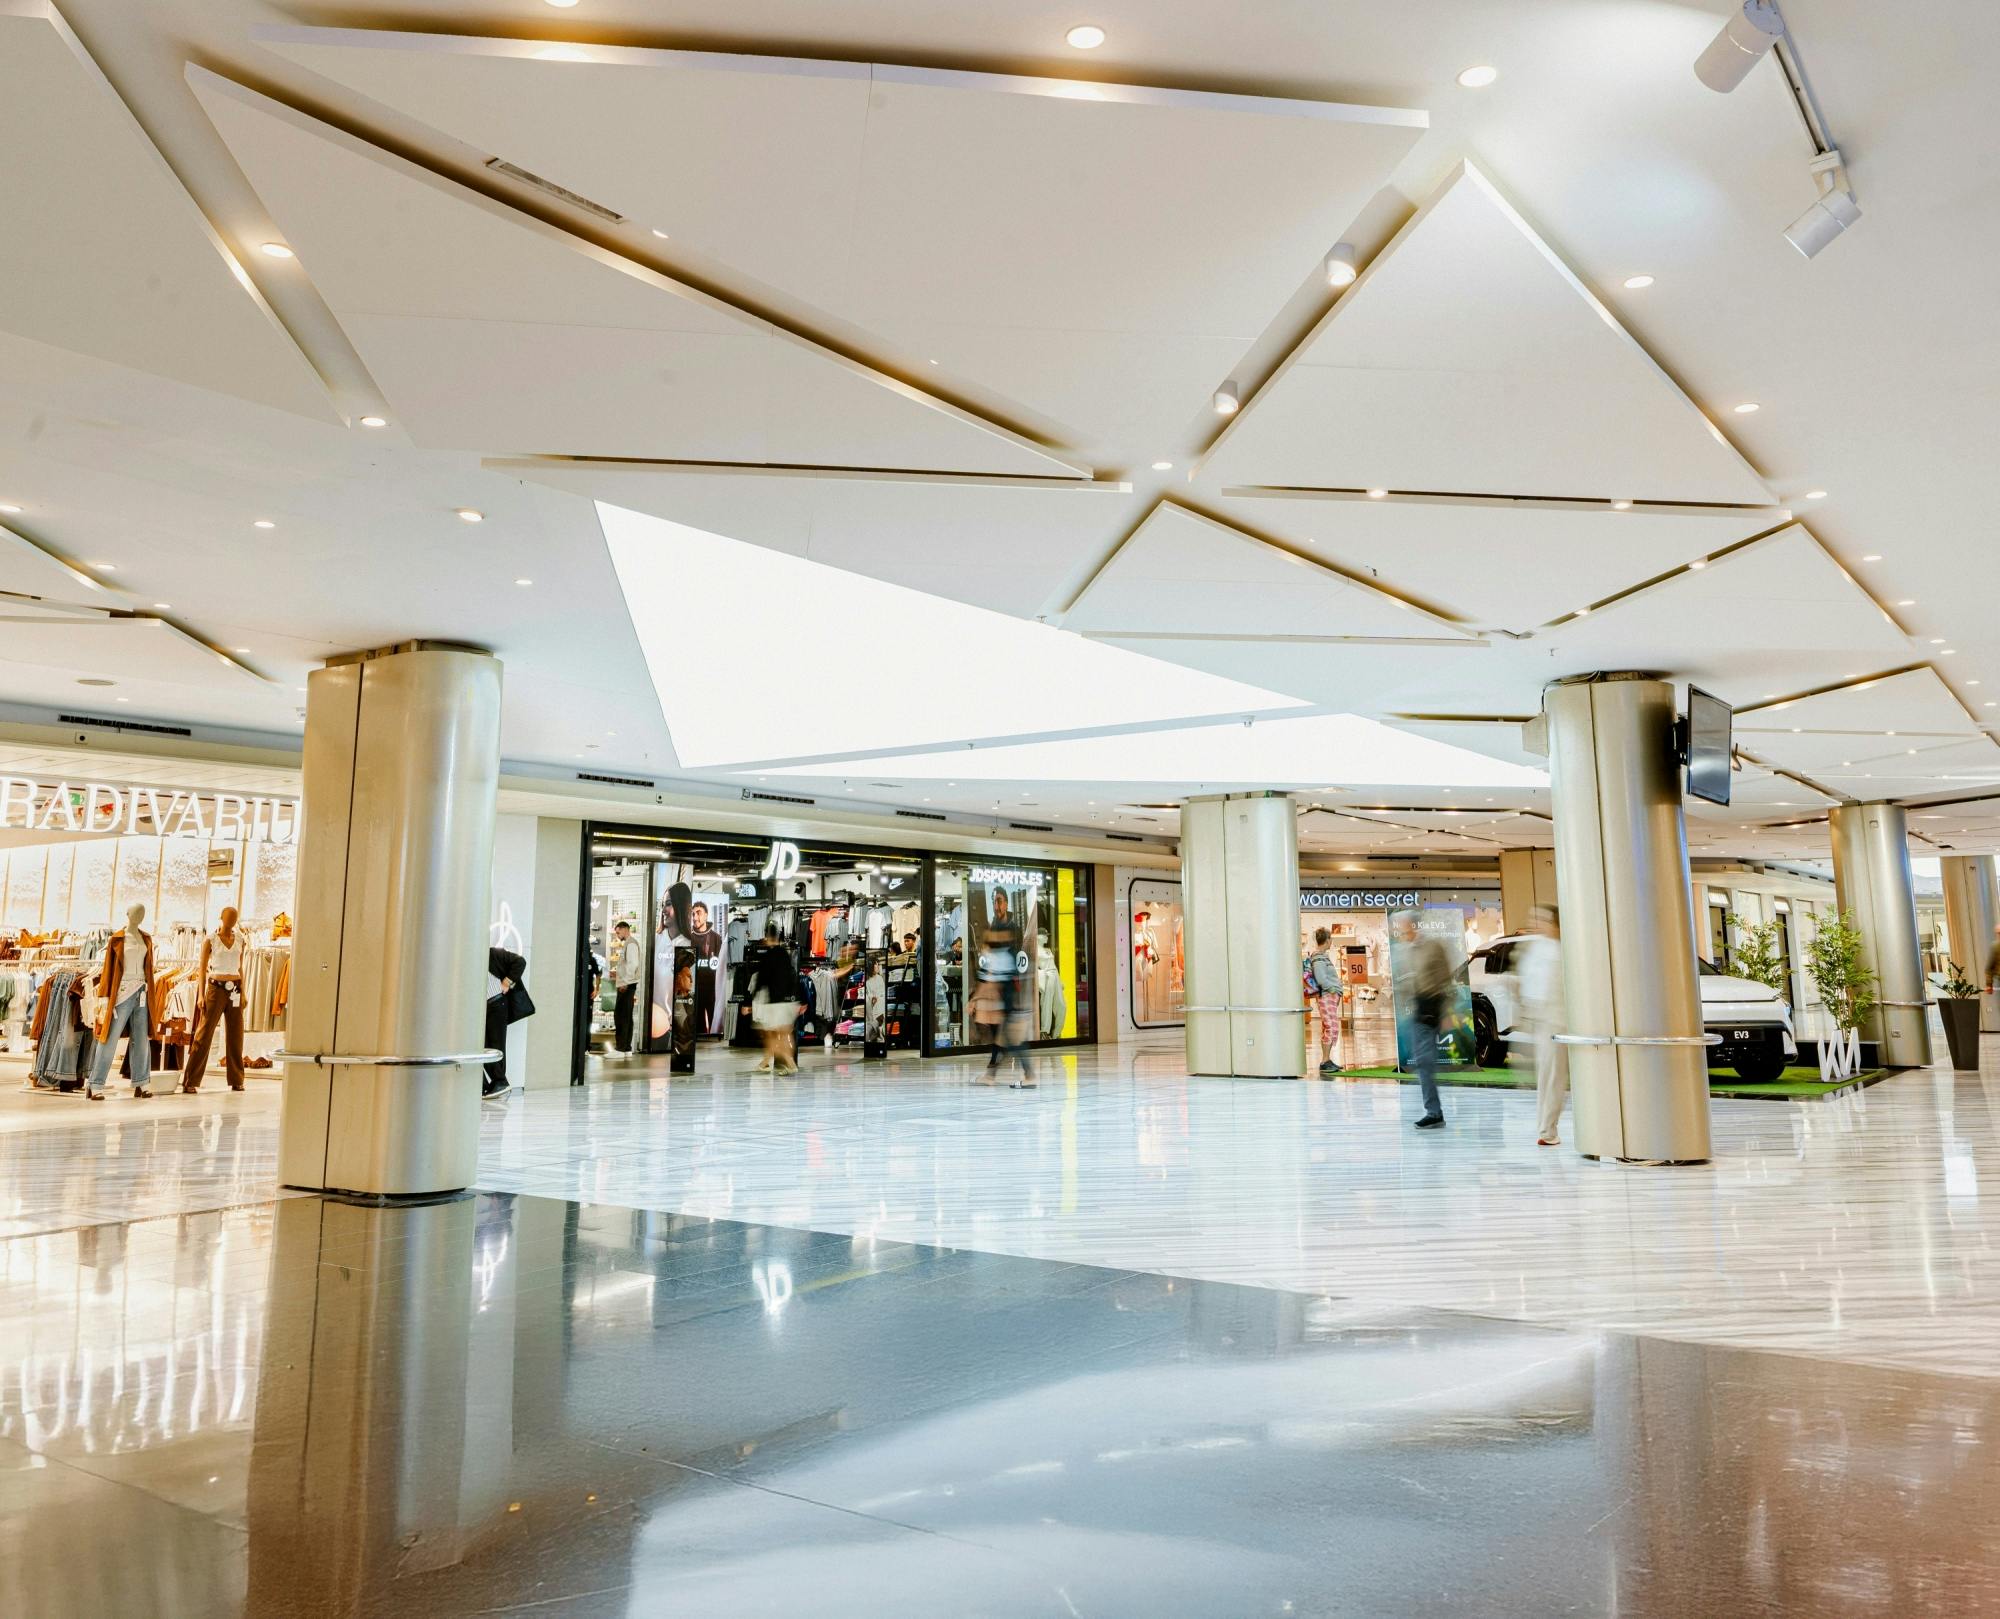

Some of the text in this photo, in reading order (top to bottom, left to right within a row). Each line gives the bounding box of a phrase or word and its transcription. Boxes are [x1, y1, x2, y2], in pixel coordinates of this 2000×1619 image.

[761, 841, 800, 880] JD
[969, 868, 1043, 886] JDSPORTS.ES
[1351, 964, 1363, 974] 50
[1734, 1030, 1749, 1039] EV3
